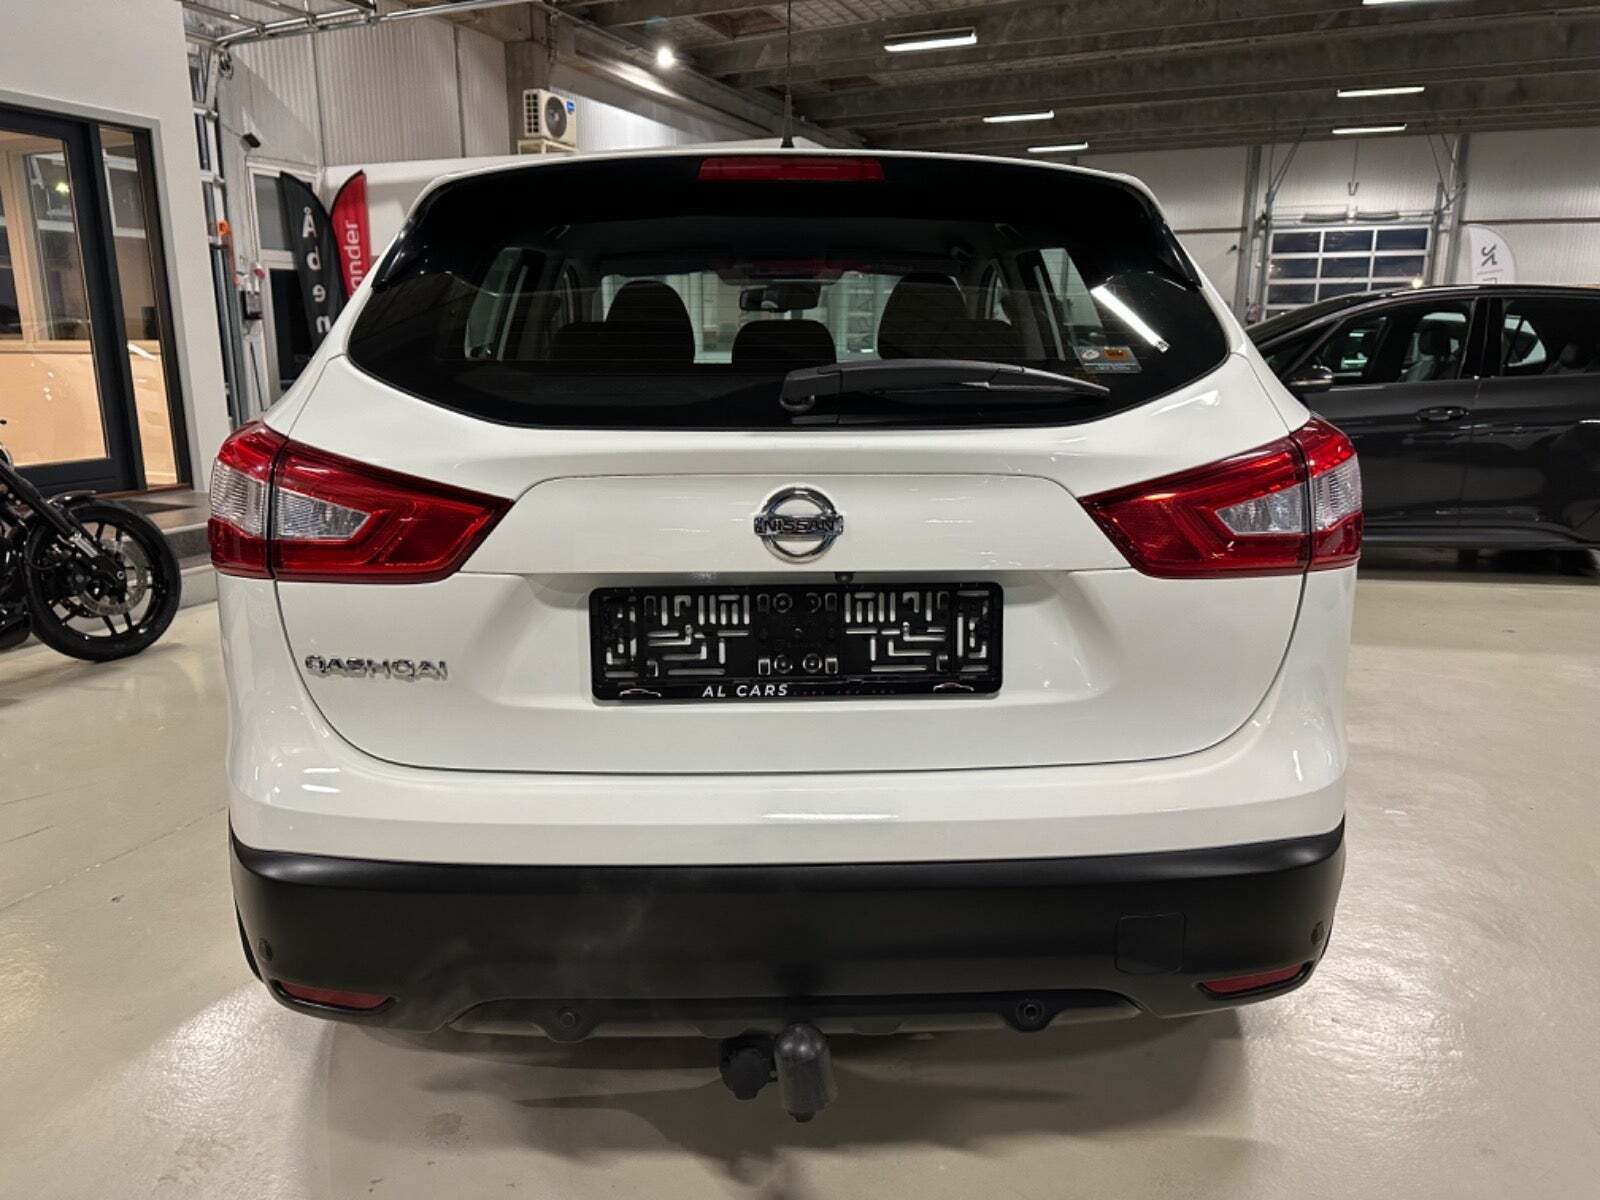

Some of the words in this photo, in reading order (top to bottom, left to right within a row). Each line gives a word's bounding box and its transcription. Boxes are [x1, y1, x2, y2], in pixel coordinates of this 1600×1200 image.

[344, 219, 364, 297] ander
[763, 518, 836, 534] NISSAN
[305, 655, 449, 681] QASHQAI
[702, 685, 726, 698] AL
[736, 684, 788, 697] CARS
